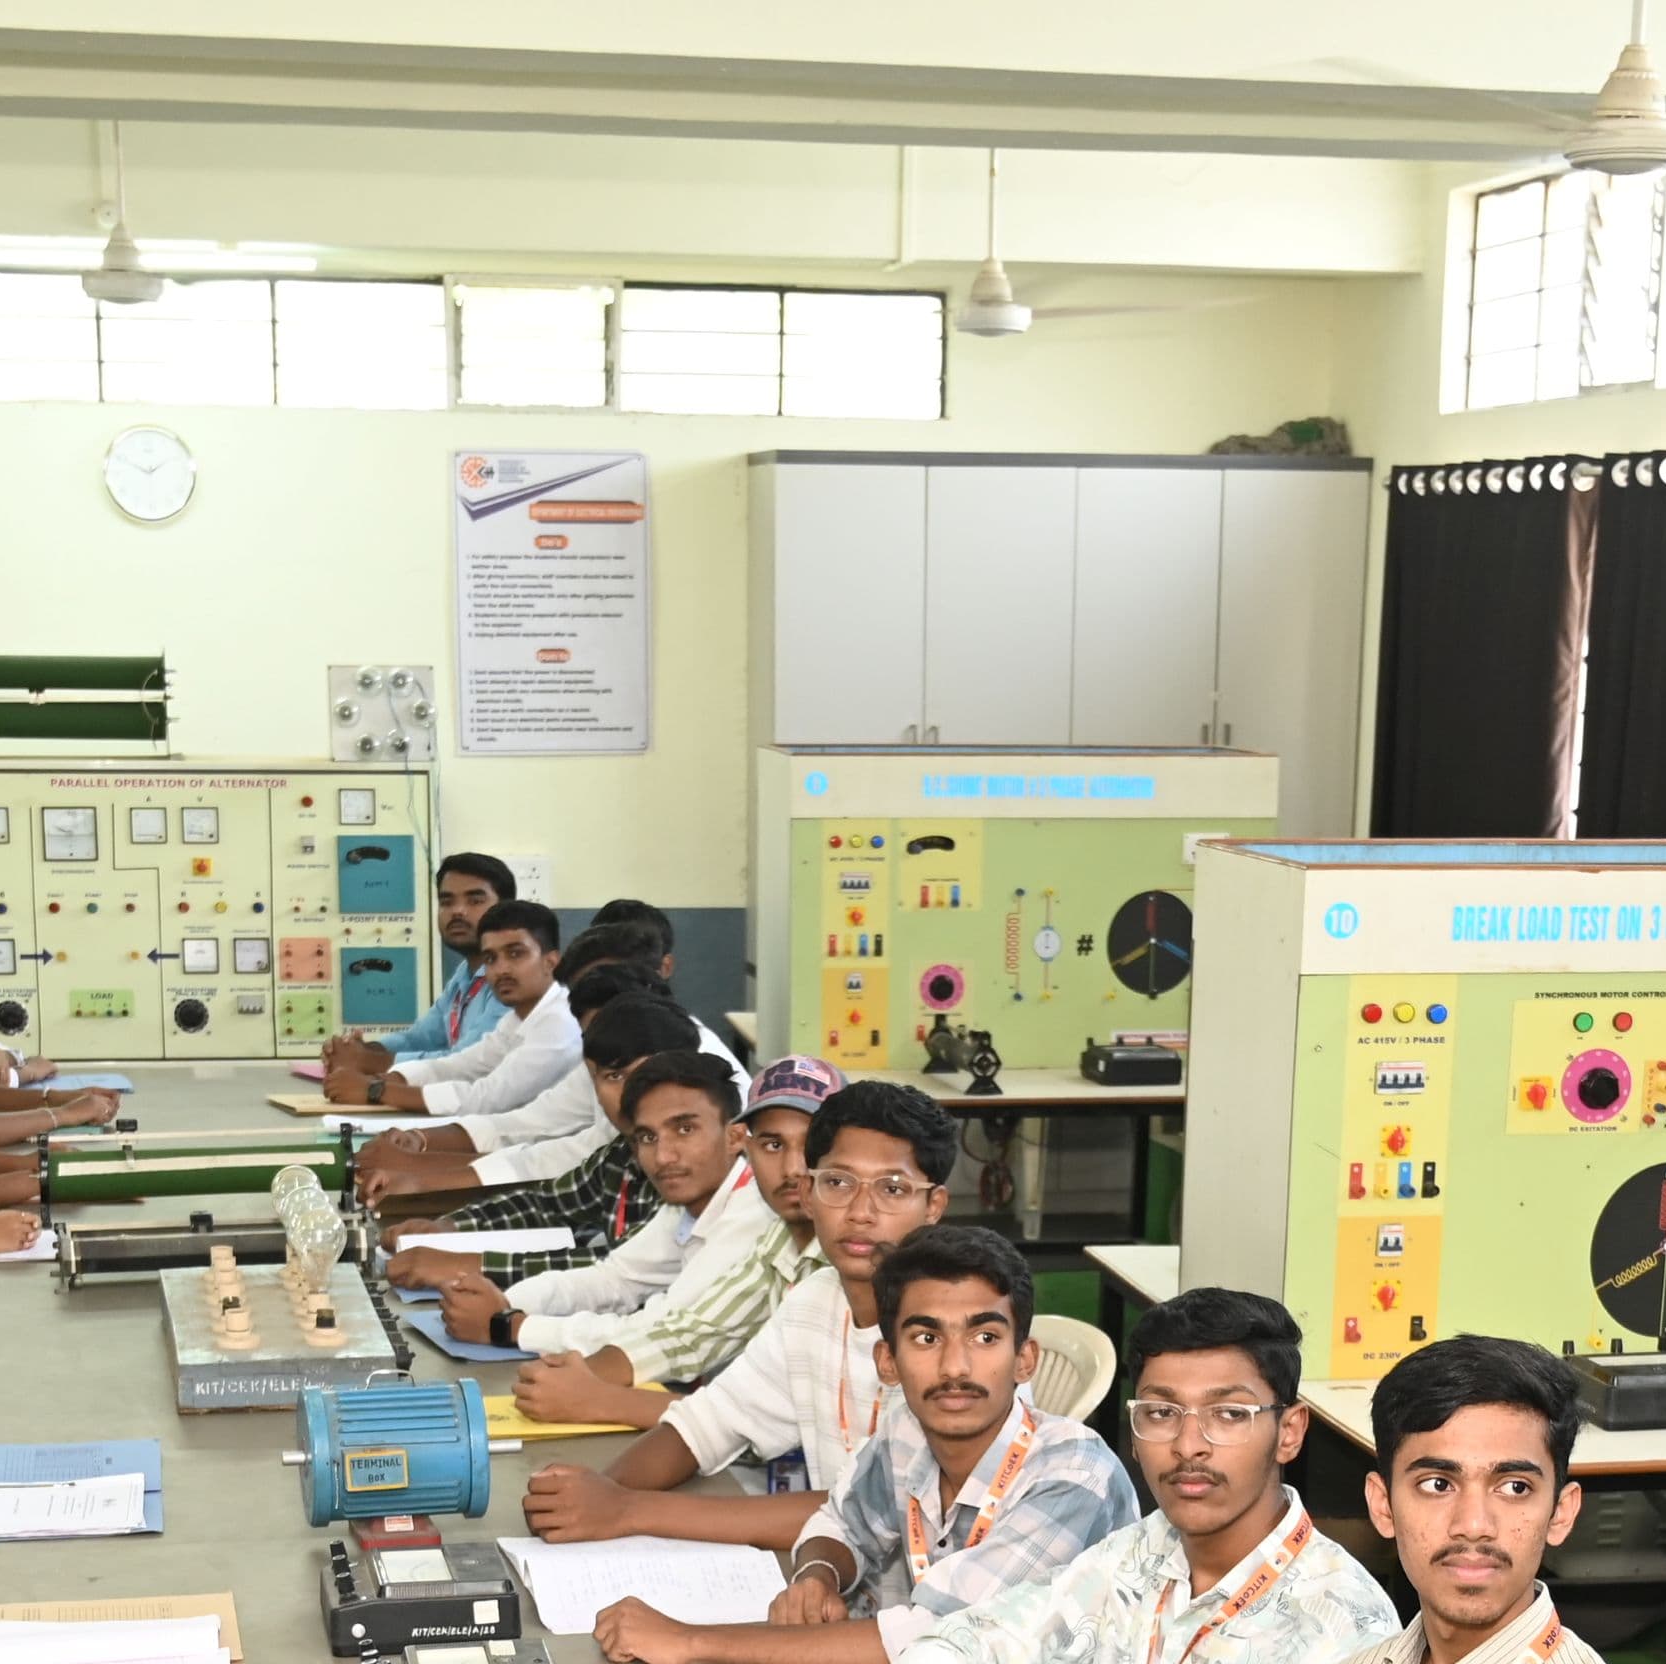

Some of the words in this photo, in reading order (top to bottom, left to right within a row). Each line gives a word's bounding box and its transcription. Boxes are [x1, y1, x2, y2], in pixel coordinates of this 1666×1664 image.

[50, 778, 109, 788] PARALLEL
[114, 778, 184, 788] OPERATION
[190, 778, 204, 788] OF
[209, 779, 288, 788] ALTERNATOR
[1329, 908, 1353, 936] 10
[1452, 905, 1513, 941] BREAK
[1517, 905, 1563, 941] LOAD
[1569, 905, 1611, 941] TEST
[1616, 905, 1643, 941] ON
[1650, 905, 1662, 941] 3
[350, 1457, 402, 1469] TERMINAL
